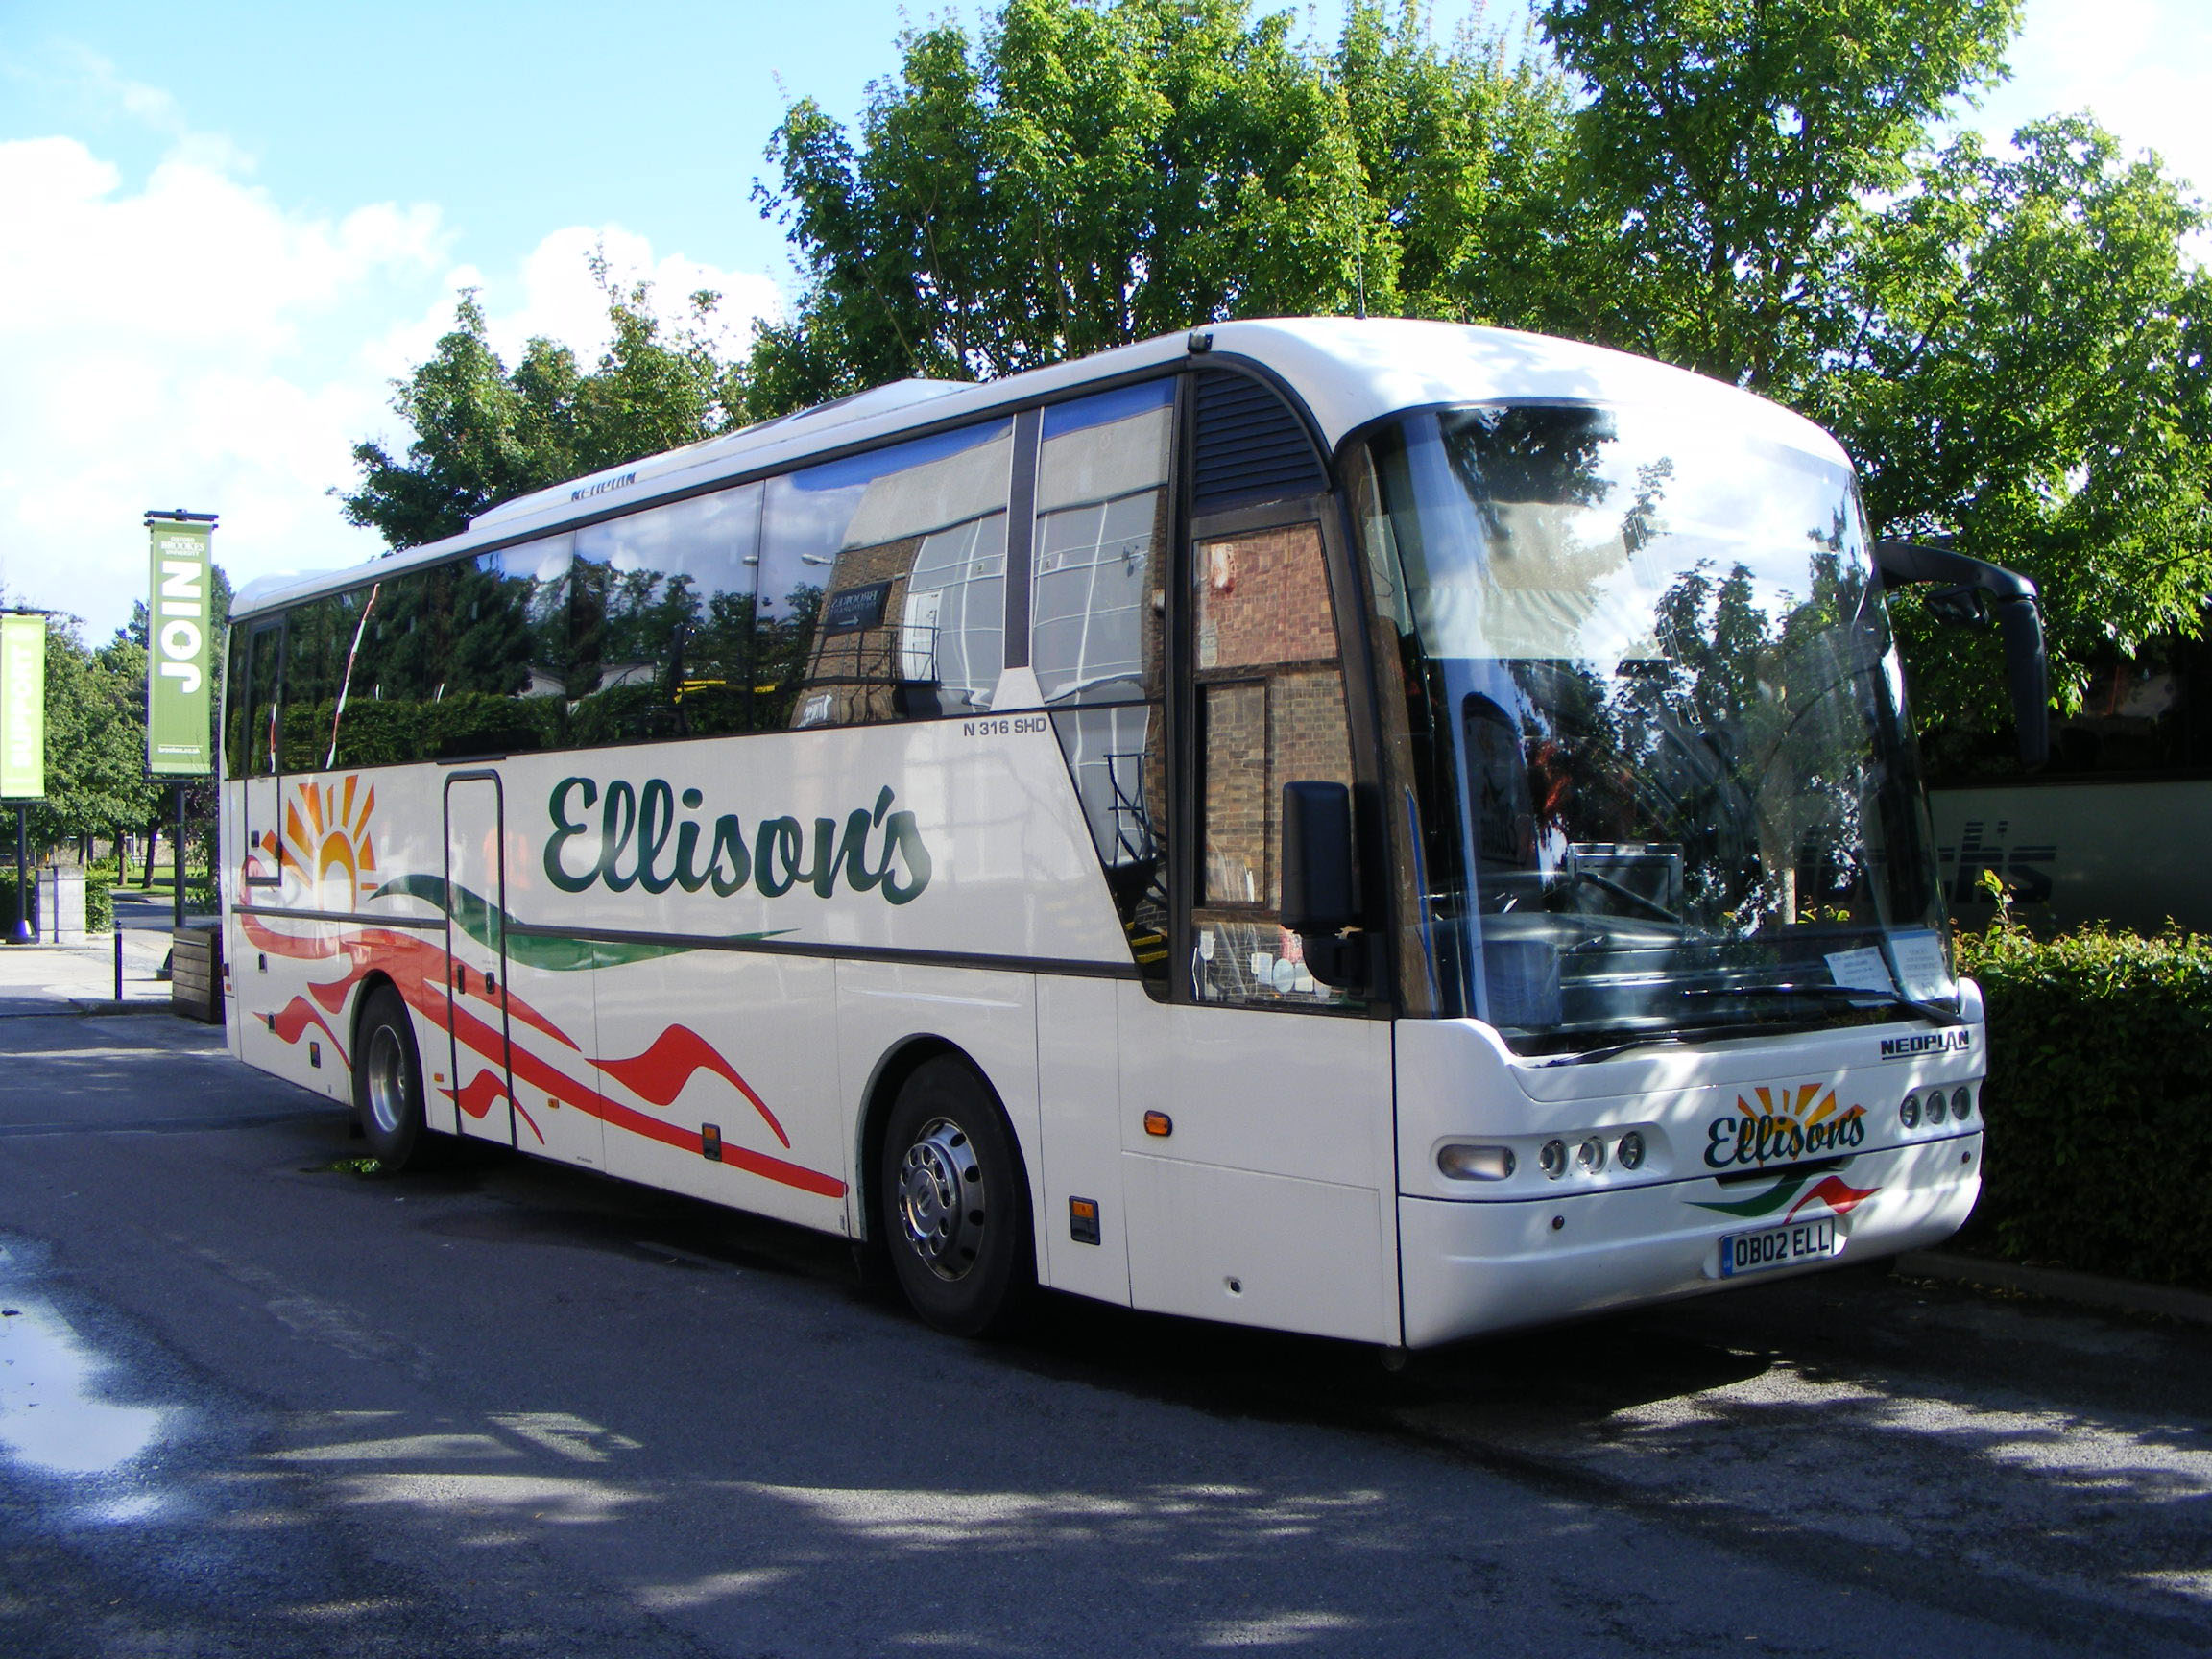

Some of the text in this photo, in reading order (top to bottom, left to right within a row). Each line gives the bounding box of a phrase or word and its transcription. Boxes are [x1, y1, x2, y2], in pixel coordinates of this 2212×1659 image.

[161, 541, 204, 551] BROOKES
[161, 561, 202, 693] JOIN
[964, 717, 1046, 736] N 316 SHD
[543, 776, 932, 905] Ellison's
[1881, 1030, 1969, 1056] NEOPLAN
[1704, 1109, 1865, 1168] Ellison's
[1792, 1224, 1830, 1257] ELL
